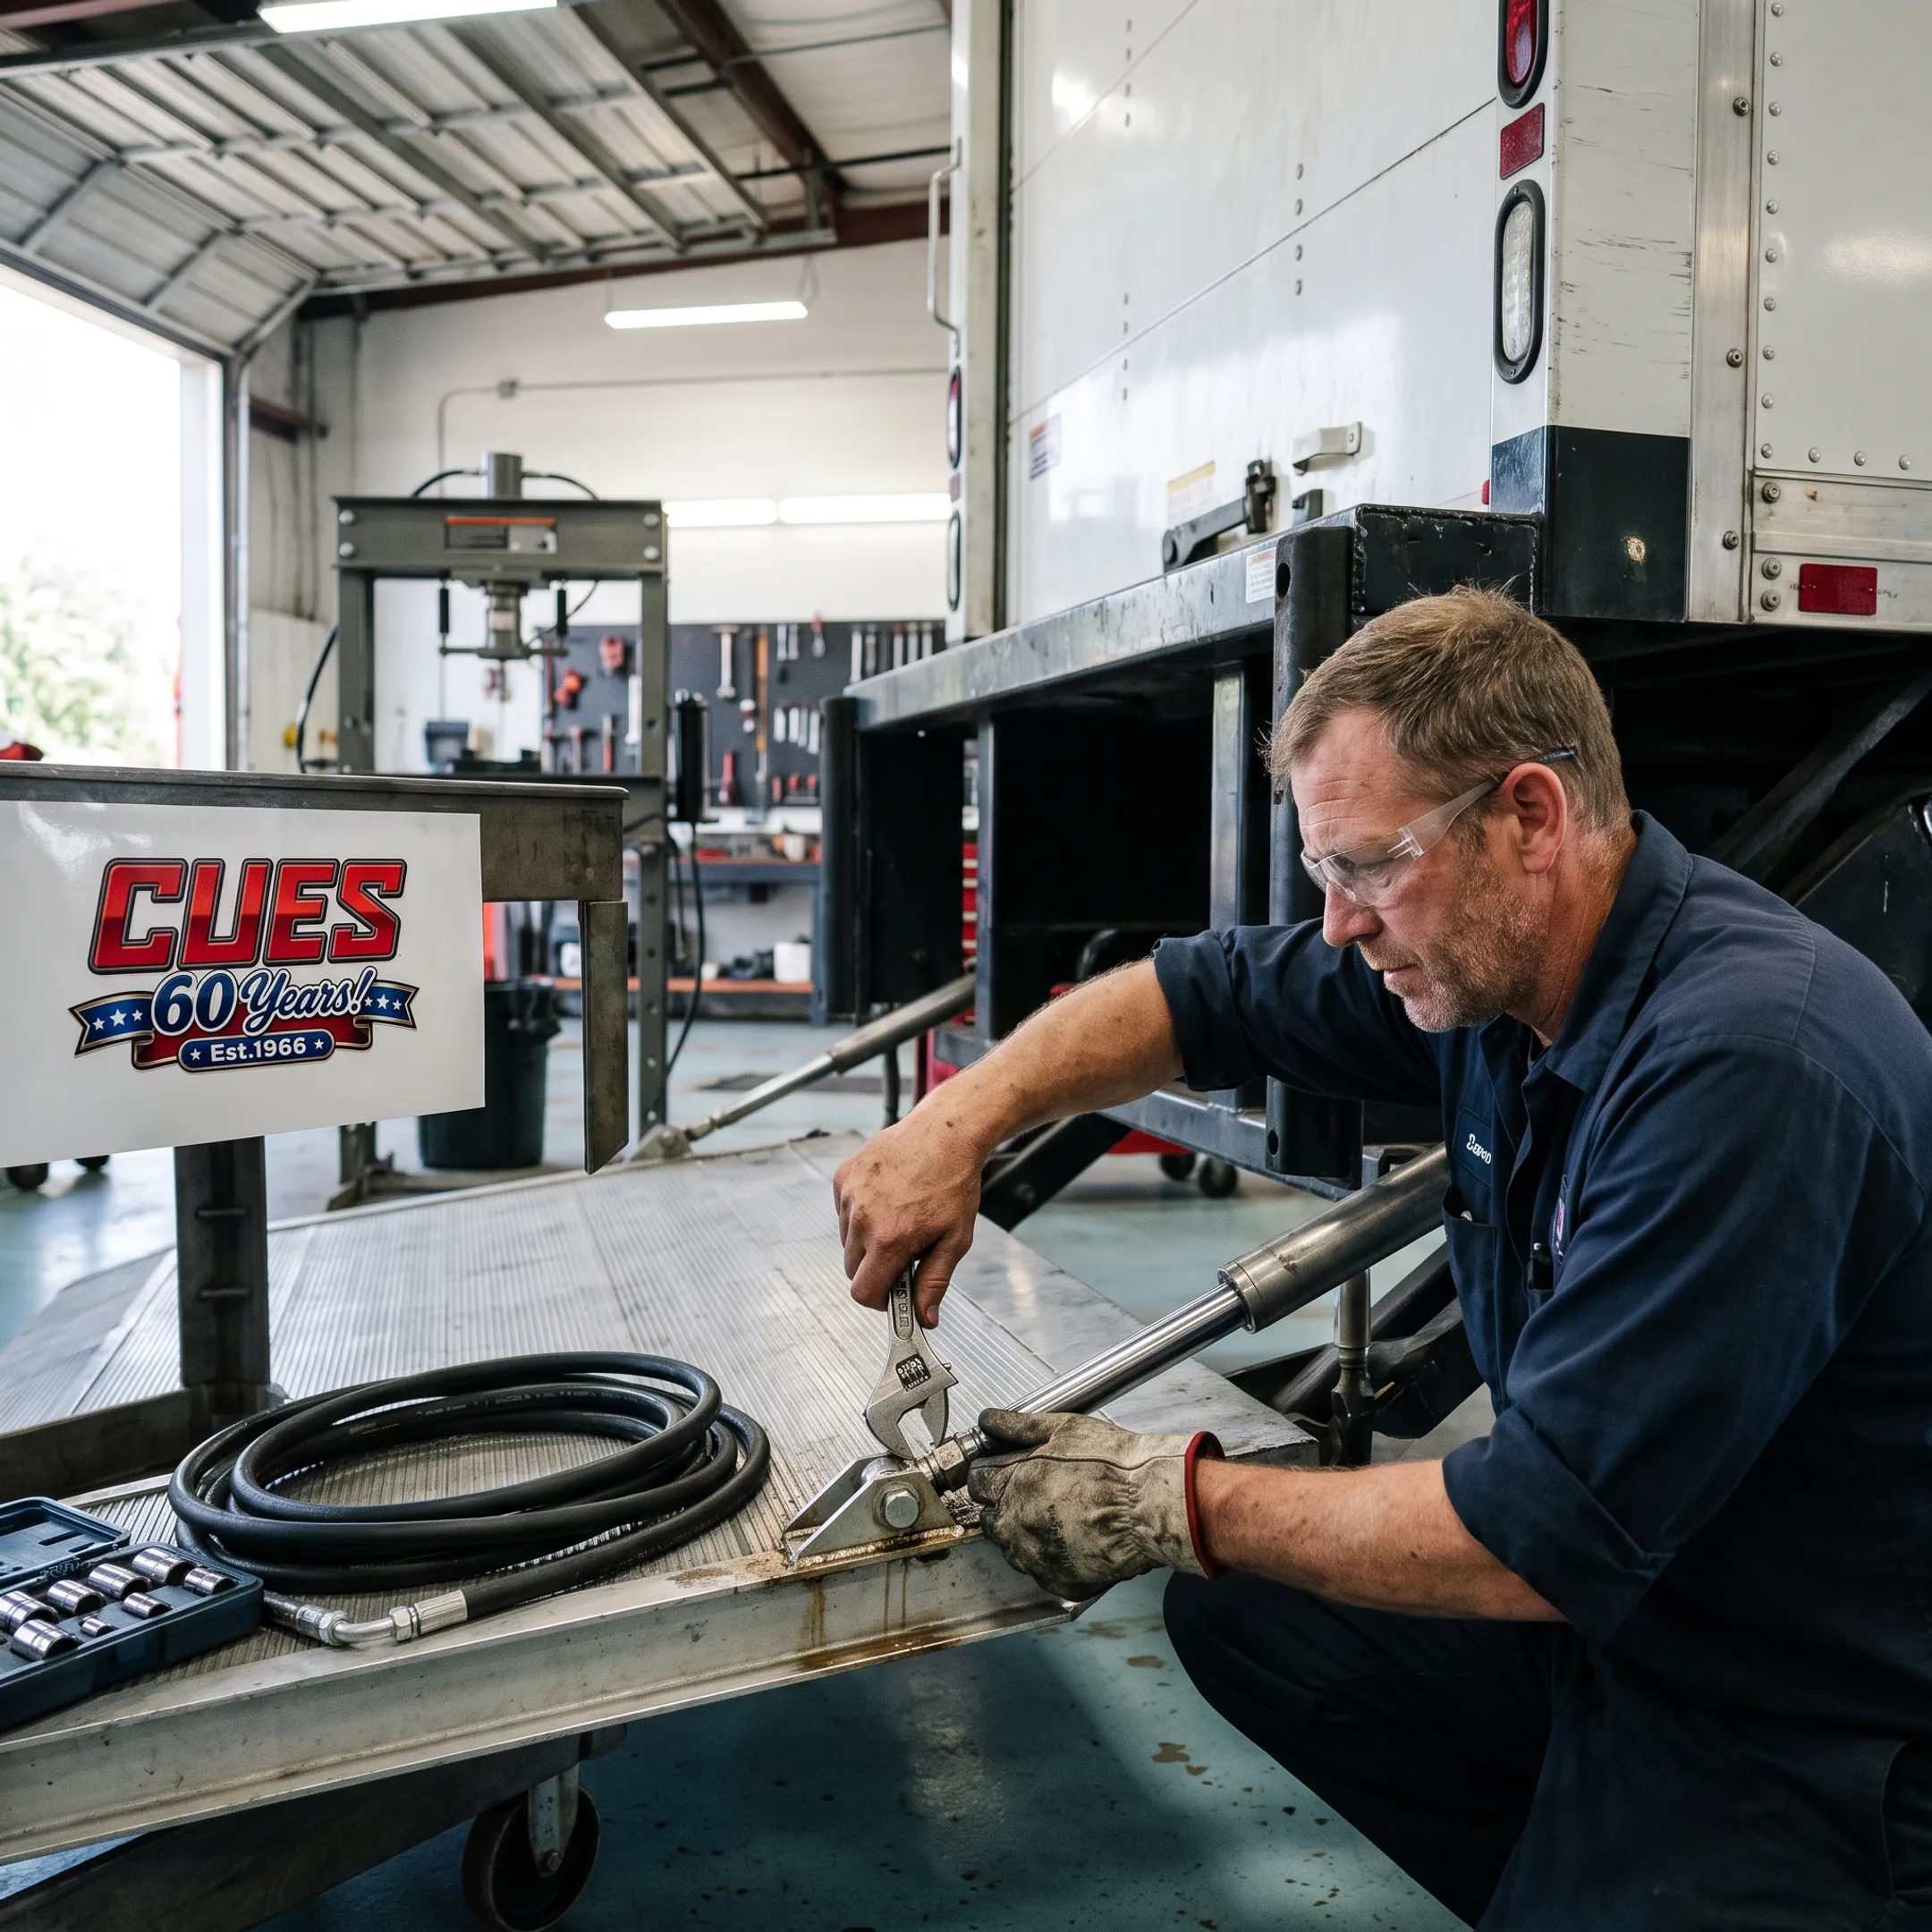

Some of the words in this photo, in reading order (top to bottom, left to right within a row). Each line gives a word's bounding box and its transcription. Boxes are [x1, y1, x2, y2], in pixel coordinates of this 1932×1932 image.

[88, 858, 407, 973] CUES
[152, 970, 236, 1036] 60
[239, 966, 377, 1037] Years!
[210, 1037, 306, 1063] Est.1966
